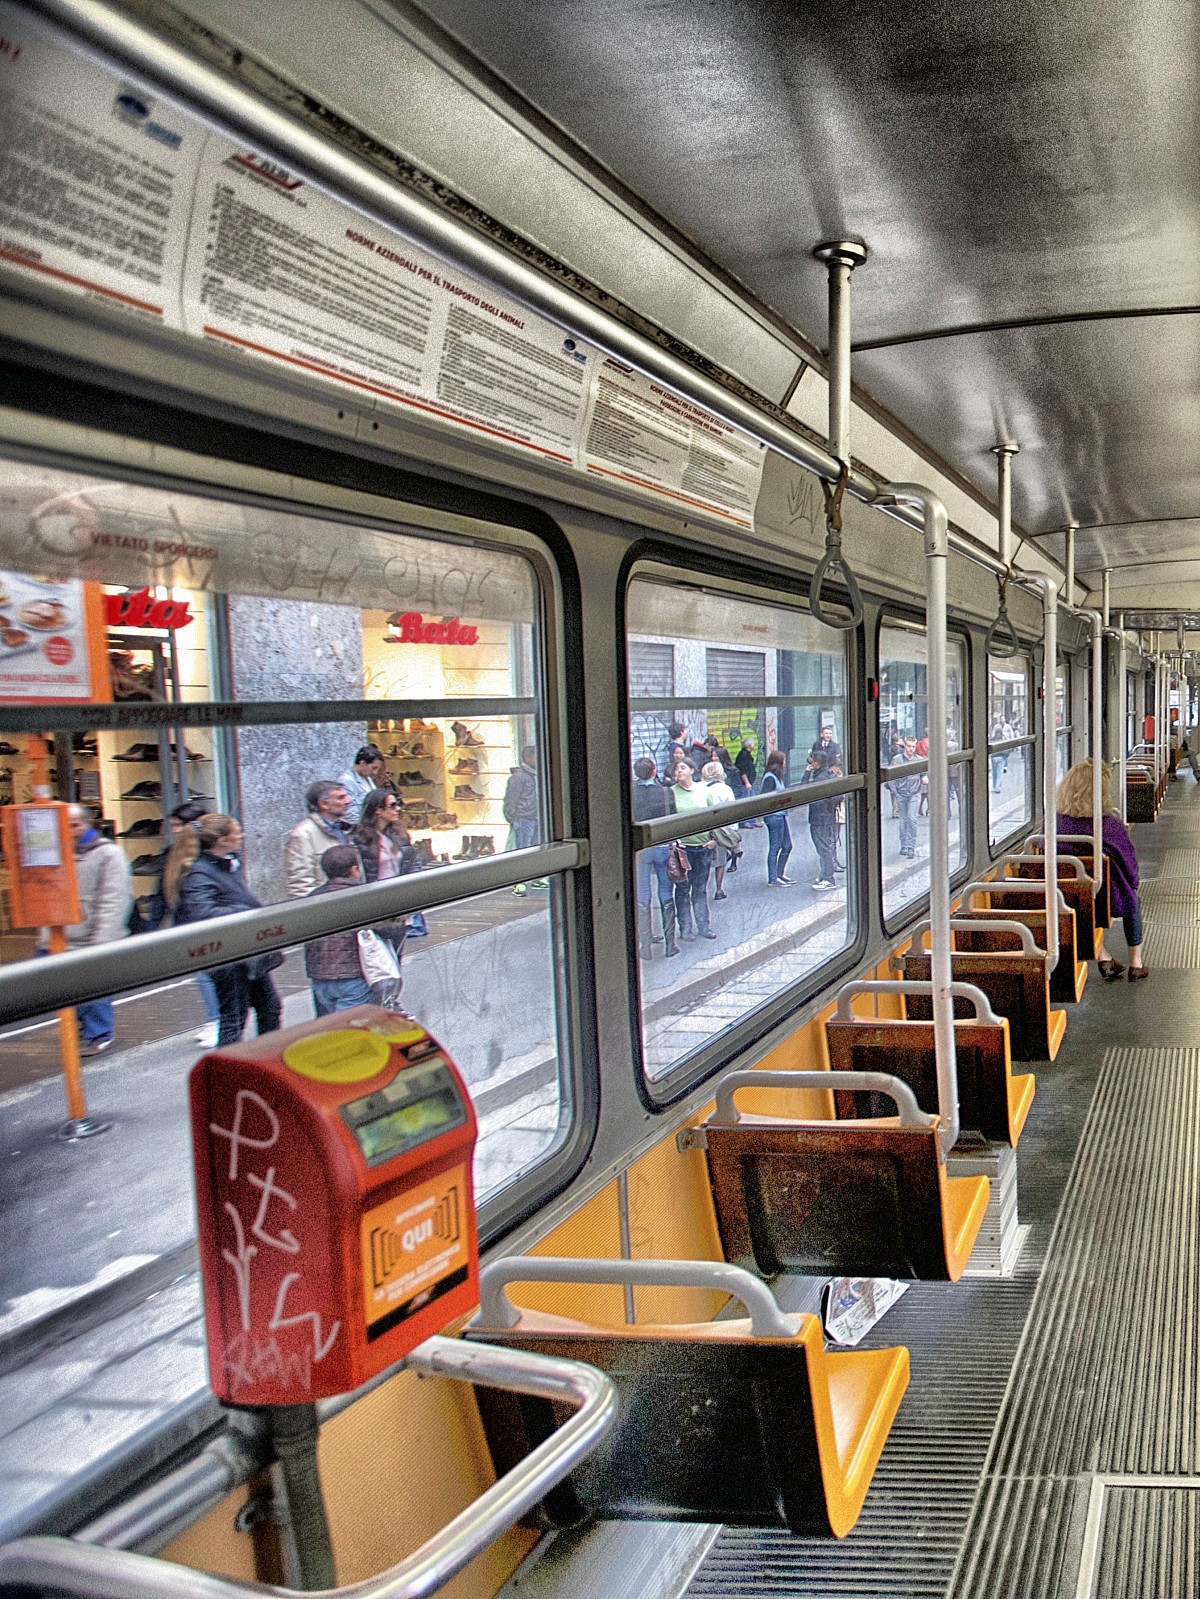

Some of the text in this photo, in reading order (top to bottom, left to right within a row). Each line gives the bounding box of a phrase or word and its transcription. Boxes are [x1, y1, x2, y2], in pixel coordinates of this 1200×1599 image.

[345, 229, 526, 330] NORME AZIENDALI PER IL TRASPORTO DEGLI ANIMALI
[91, 531, 148, 551] VIETATO
[102, 586, 195, 630] ta
[395, 611, 480, 646] Bata
[401, 1217, 433, 1252] QUI
